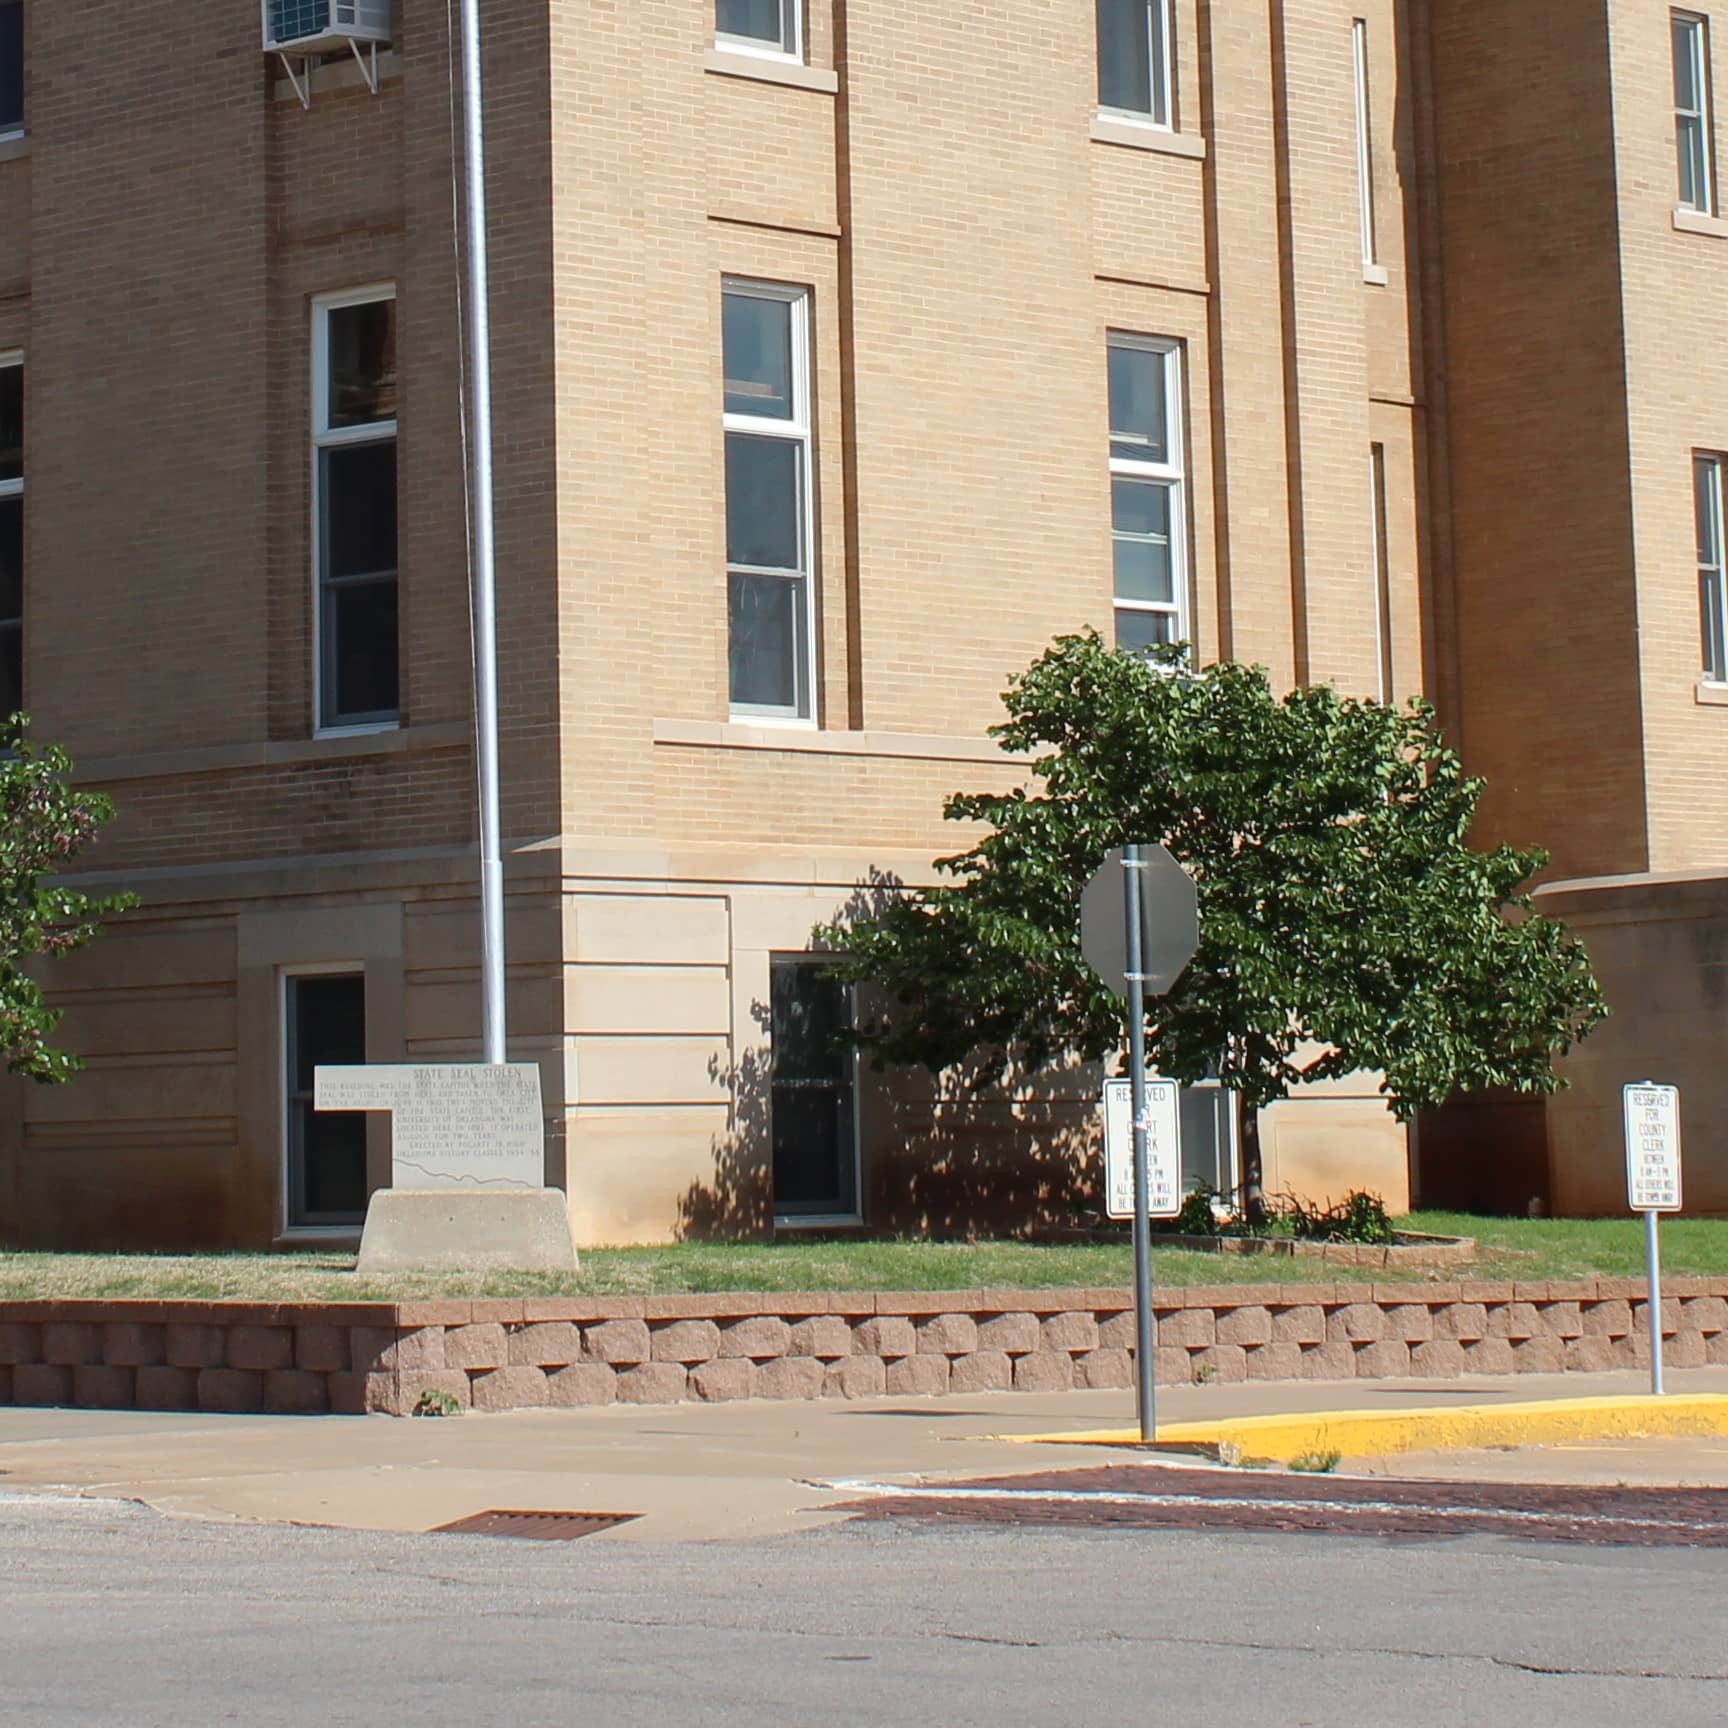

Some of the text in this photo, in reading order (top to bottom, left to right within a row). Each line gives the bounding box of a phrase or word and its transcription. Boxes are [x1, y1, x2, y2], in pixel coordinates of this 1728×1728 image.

[414, 1067, 522, 1080] STATE SEAL STOLEN
[1116, 1087, 1166, 1101] REVED
[1633, 1093, 1670, 1107] RESERVED
[1645, 1108, 1660, 1121] FOR
[1127, 1120, 1158, 1135] CRT
[1639, 1123, 1666, 1137] COUNTY
[1128, 1137, 1158, 1152] CRK
[1642, 1138, 1664, 1152] CLERK
[1117, 1183, 1128, 1195] ALL
[1157, 1182, 1172, 1194] WILL
[1118, 1198, 1127, 1209] BE
[1153, 1197, 1169, 1209] AWAY
